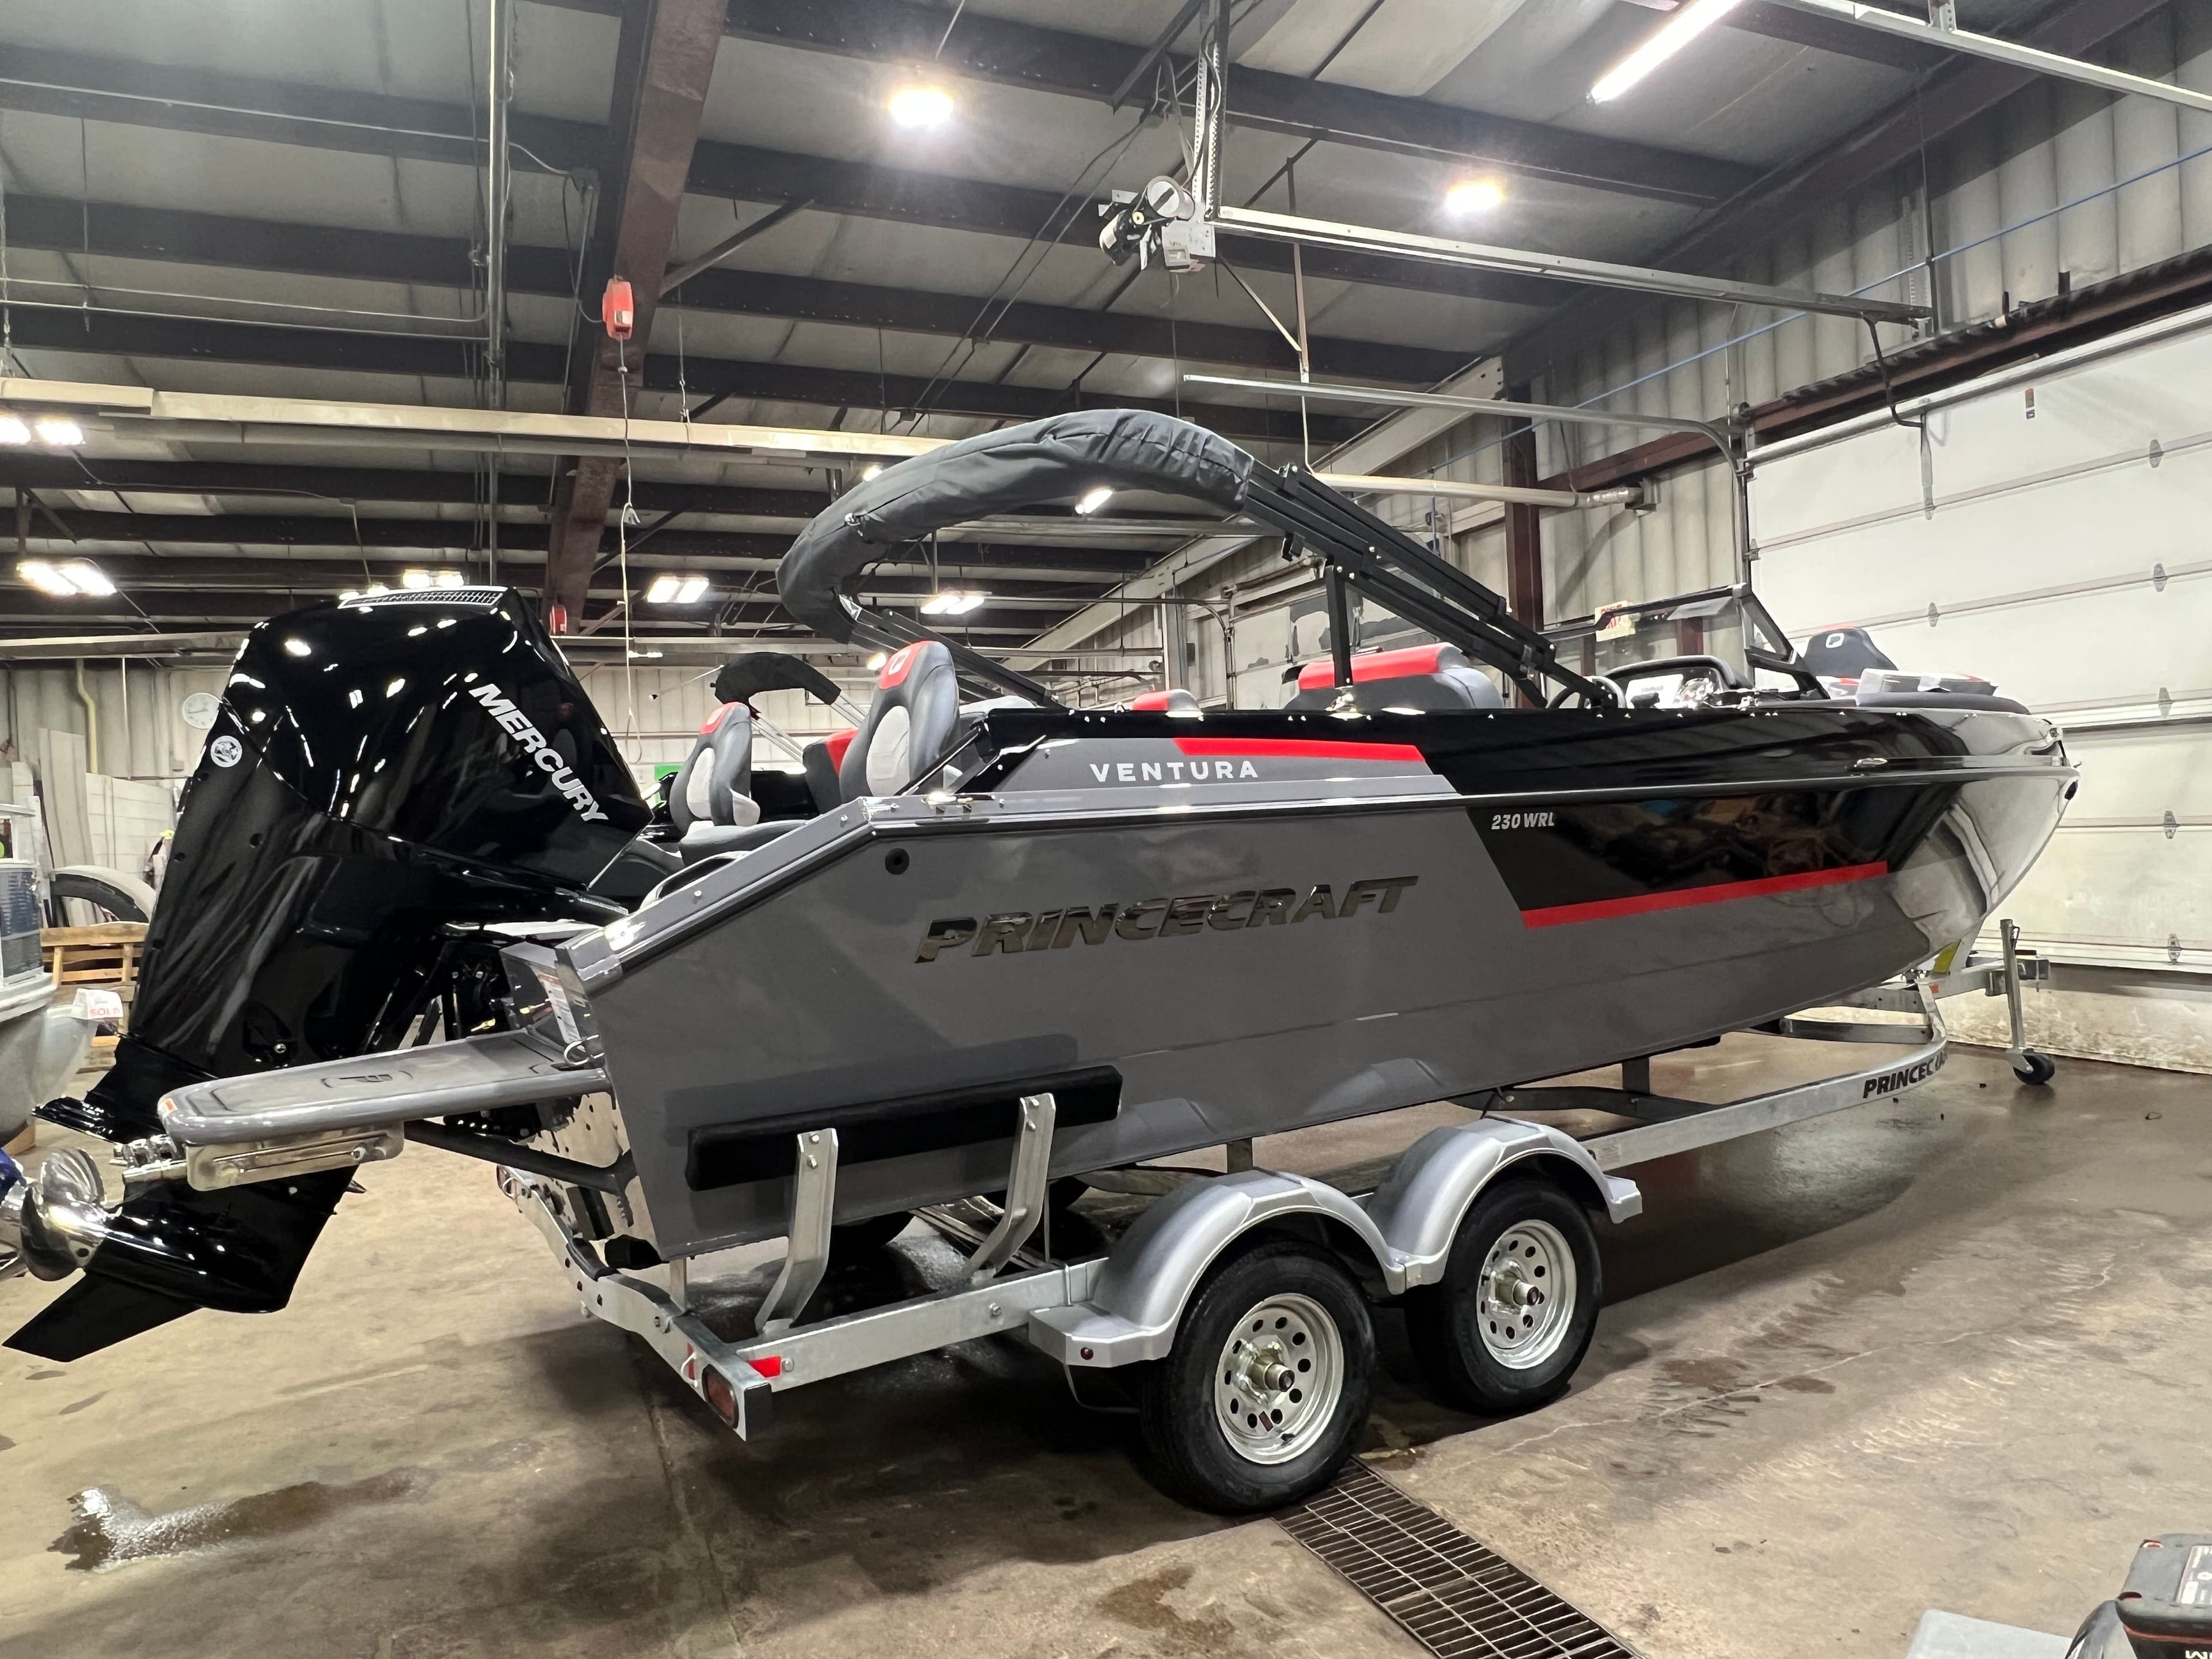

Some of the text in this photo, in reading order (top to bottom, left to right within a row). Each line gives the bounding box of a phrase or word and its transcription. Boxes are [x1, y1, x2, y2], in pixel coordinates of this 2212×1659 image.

[468, 683, 609, 821] MERCURY
[1090, 760, 1258, 782] VENTURA
[1491, 812, 1555, 830] 230 WRL
[914, 875, 1419, 964] PRINCECRAFT
[90, 1007, 120, 1017] SOLD
